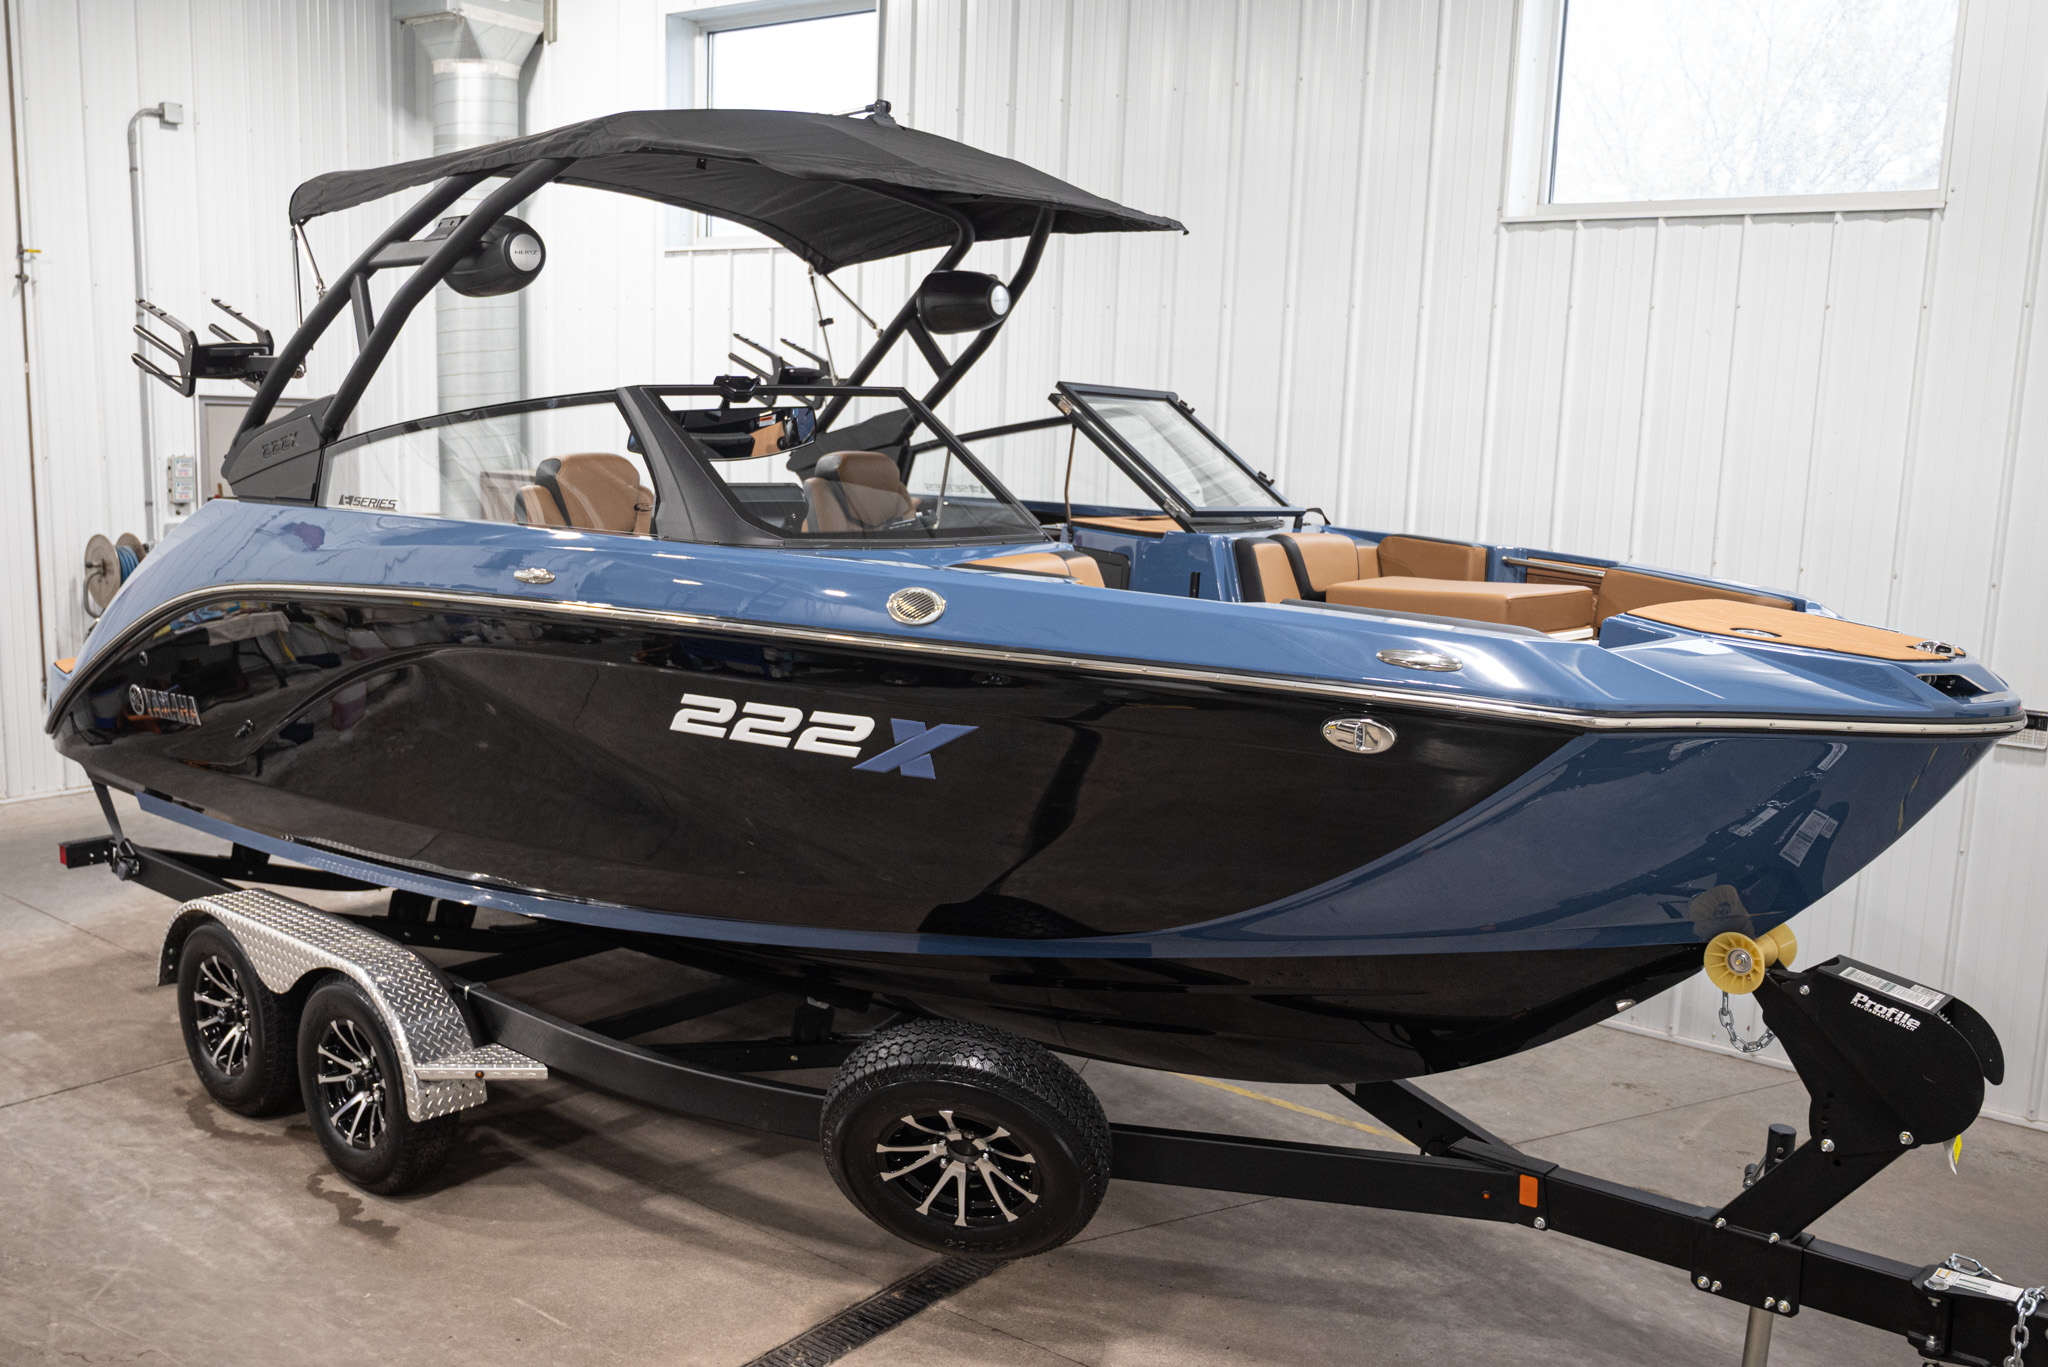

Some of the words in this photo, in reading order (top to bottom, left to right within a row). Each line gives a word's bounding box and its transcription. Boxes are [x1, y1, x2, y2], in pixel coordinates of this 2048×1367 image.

[141, 687, 202, 726] YAMAHA
[669, 693, 980, 780] 222X
[1850, 1001, 1894, 1023] PERFORMANCE
[1894, 1019, 1916, 1032] WINCH
[1852, 992, 1921, 1030] Profile
